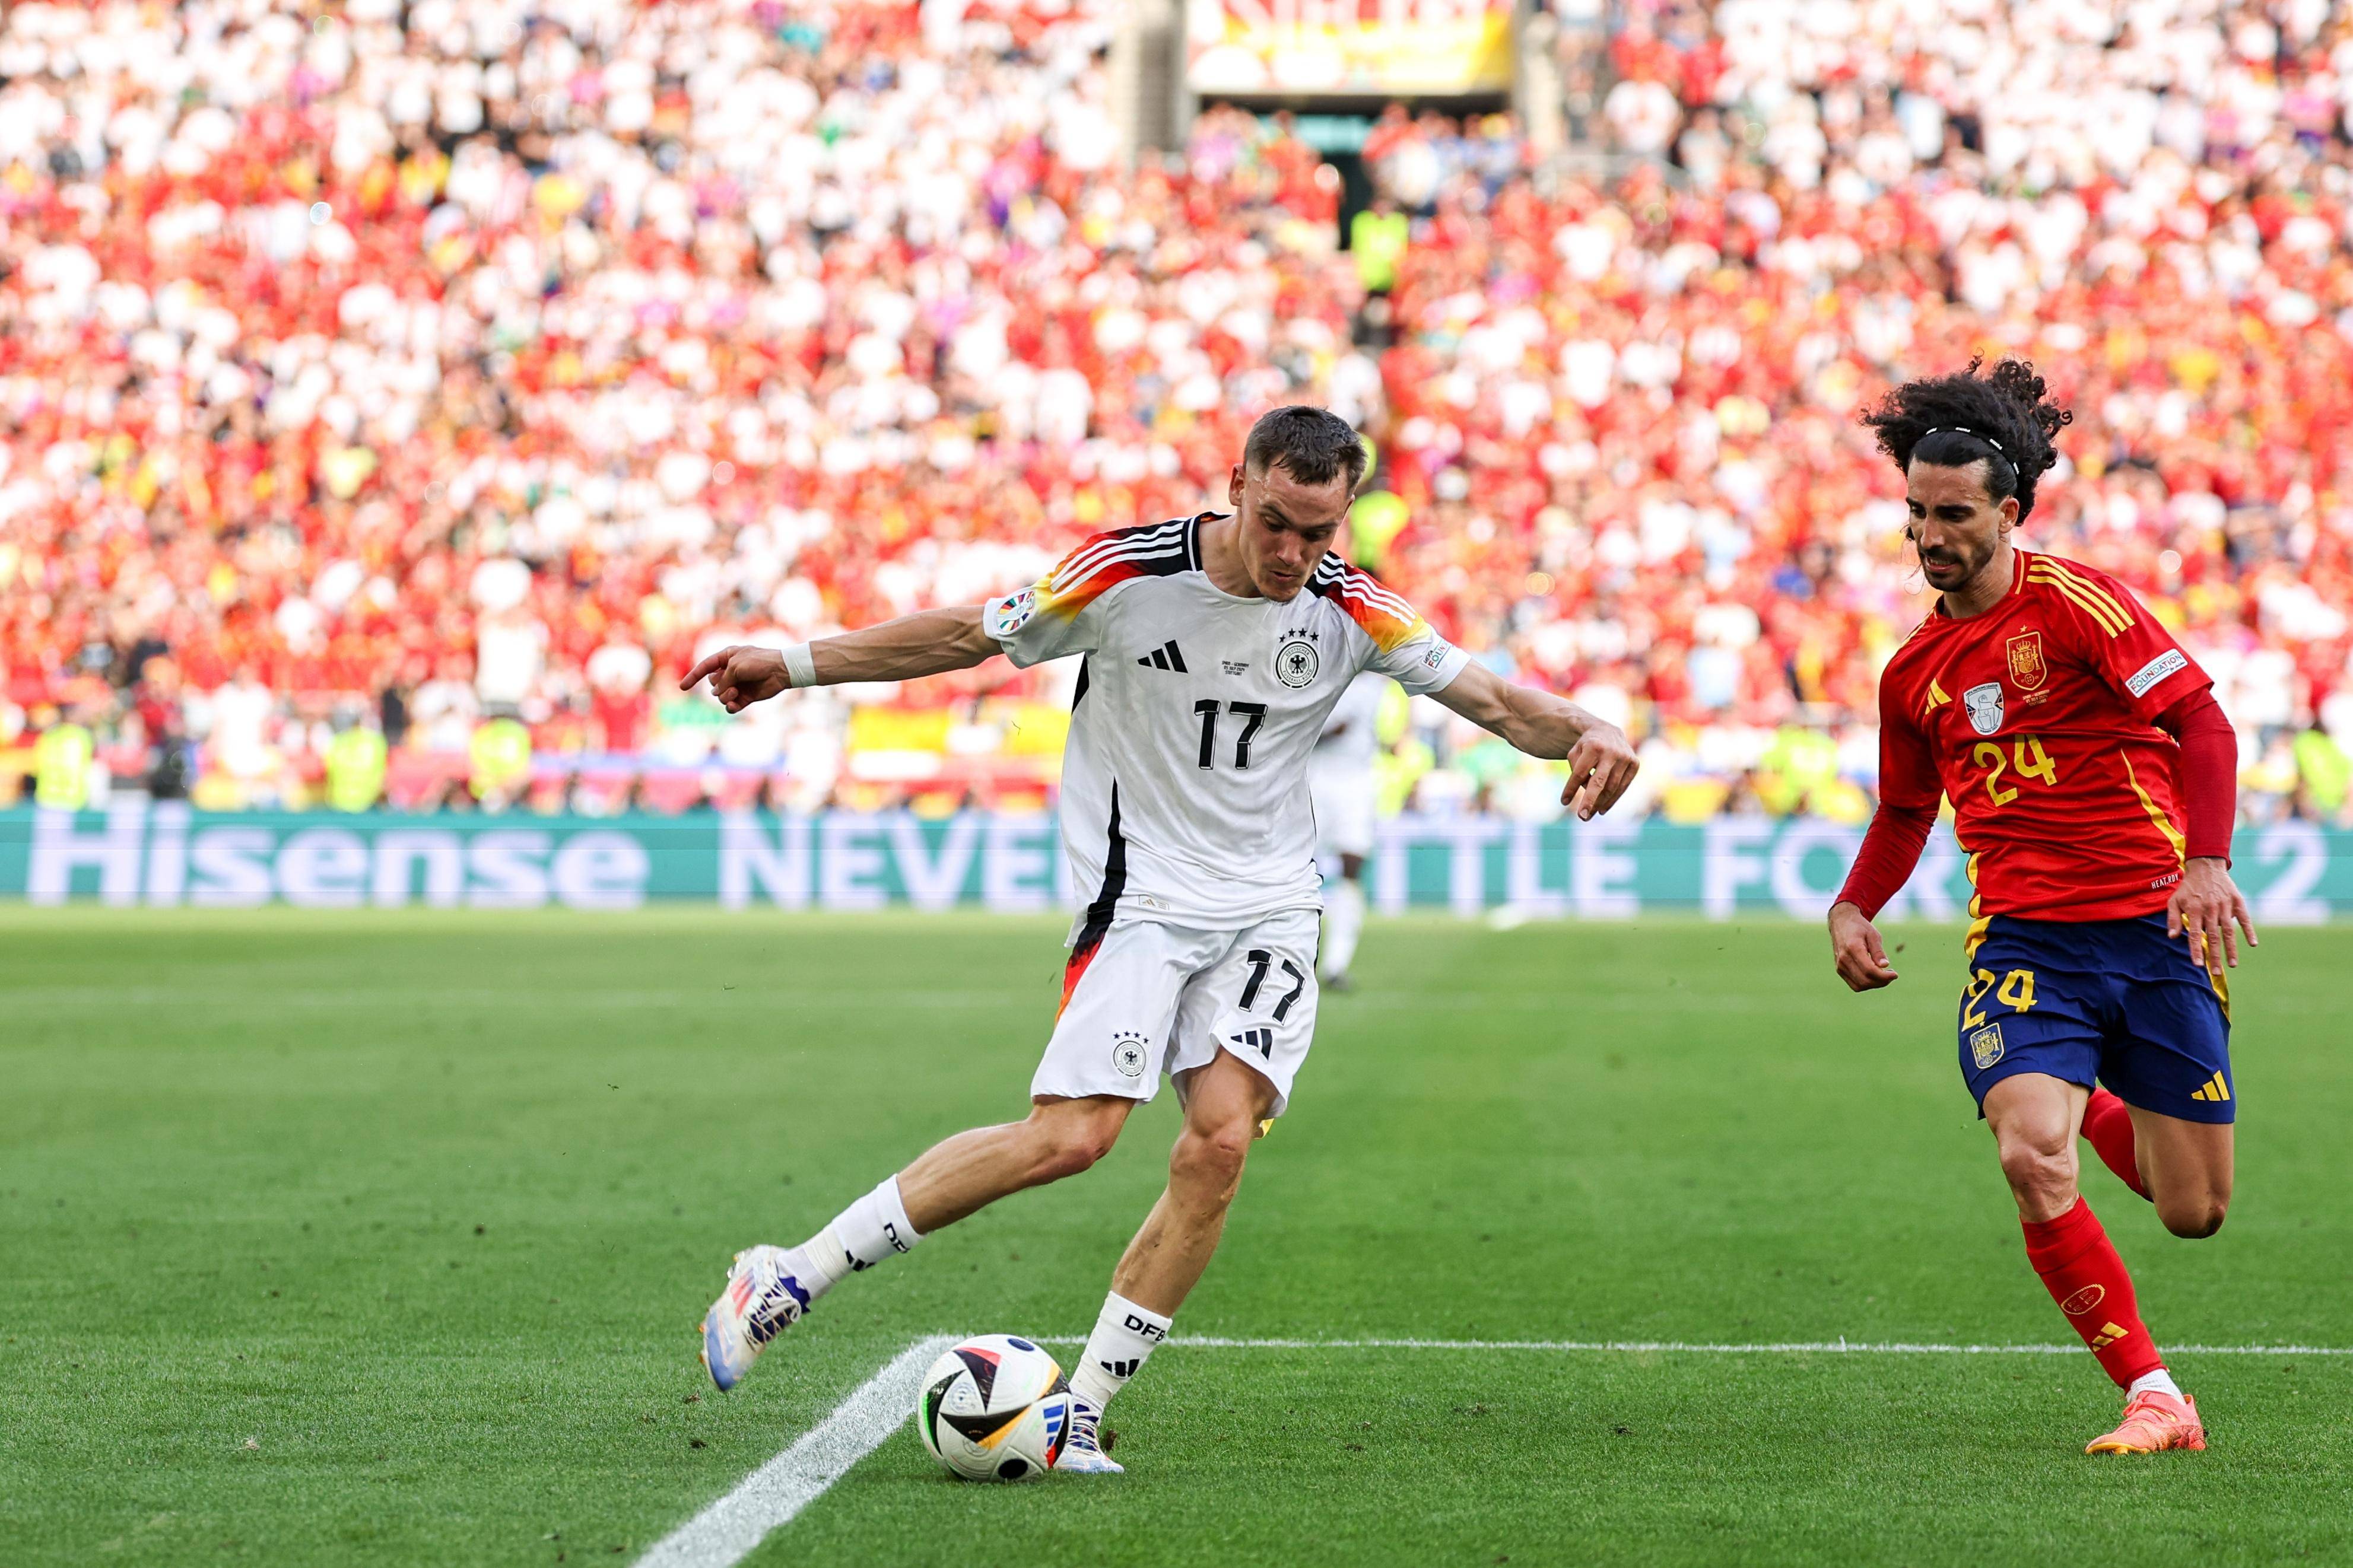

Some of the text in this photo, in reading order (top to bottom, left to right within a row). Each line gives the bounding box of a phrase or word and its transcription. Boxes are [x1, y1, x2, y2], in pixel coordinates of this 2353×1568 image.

[1424, 650, 1434, 664] UEFA
[2130, 654, 2182, 692] FOUNDATION
[1194, 699, 1268, 769] 17
[1974, 734, 2057, 807] 24
[27, 799, 650, 908] Hisense
[719, 812, 1076, 912] NEVE
[2151, 873, 2179, 890] HEAT.RDY
[1239, 949, 1306, 1026] 17
[1961, 969, 2038, 1032] 24
[1124, 1314, 1166, 1341] DFB
